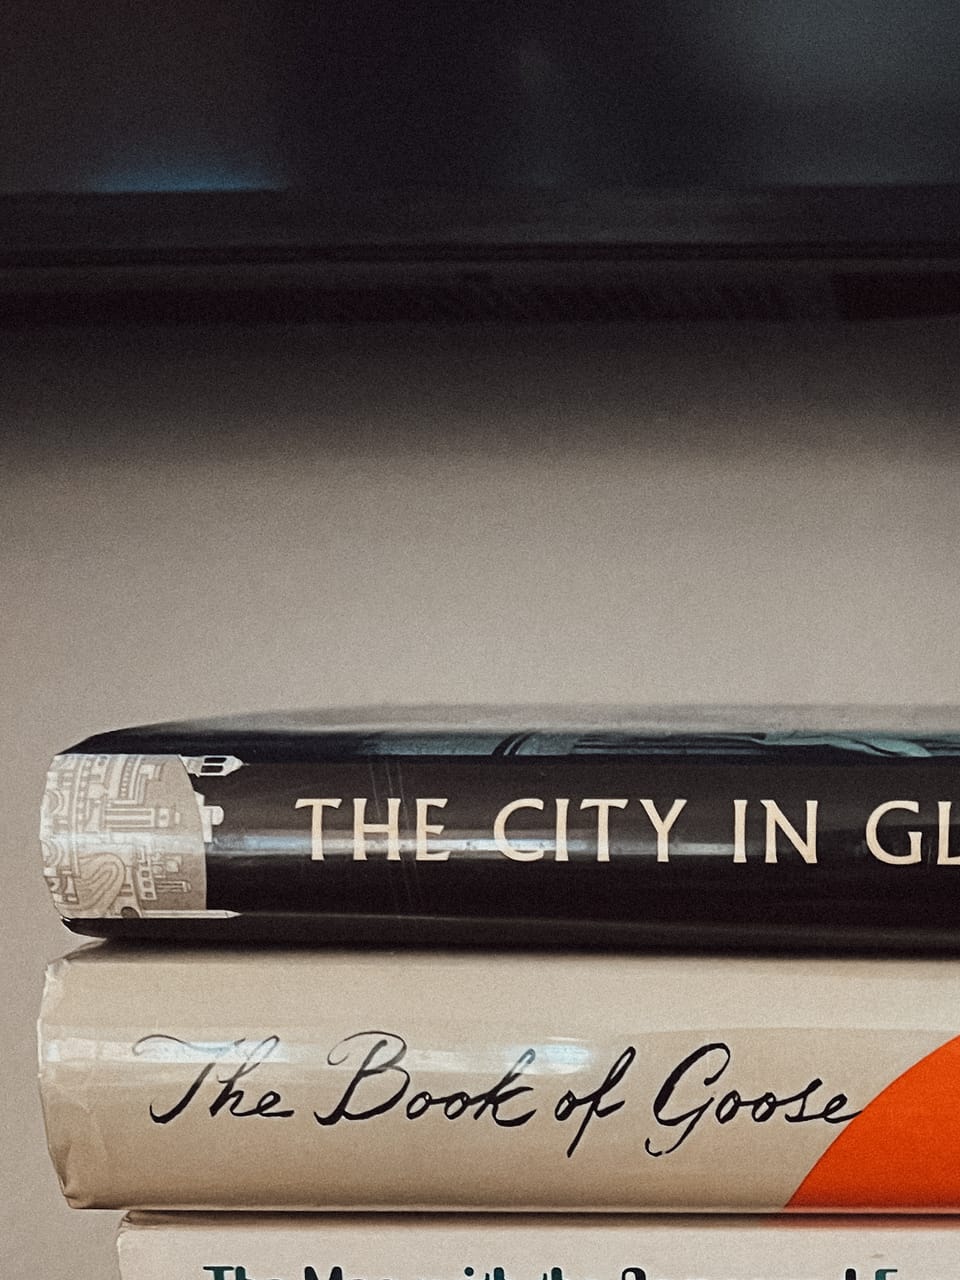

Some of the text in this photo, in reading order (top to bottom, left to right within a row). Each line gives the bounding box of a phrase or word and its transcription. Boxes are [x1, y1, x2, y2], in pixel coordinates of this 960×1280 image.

[294, 798, 451, 862] THE
[493, 798, 688, 863] CITY
[733, 799, 819, 864] IN
[131, 1031, 866, 1158] The Book of Goose
